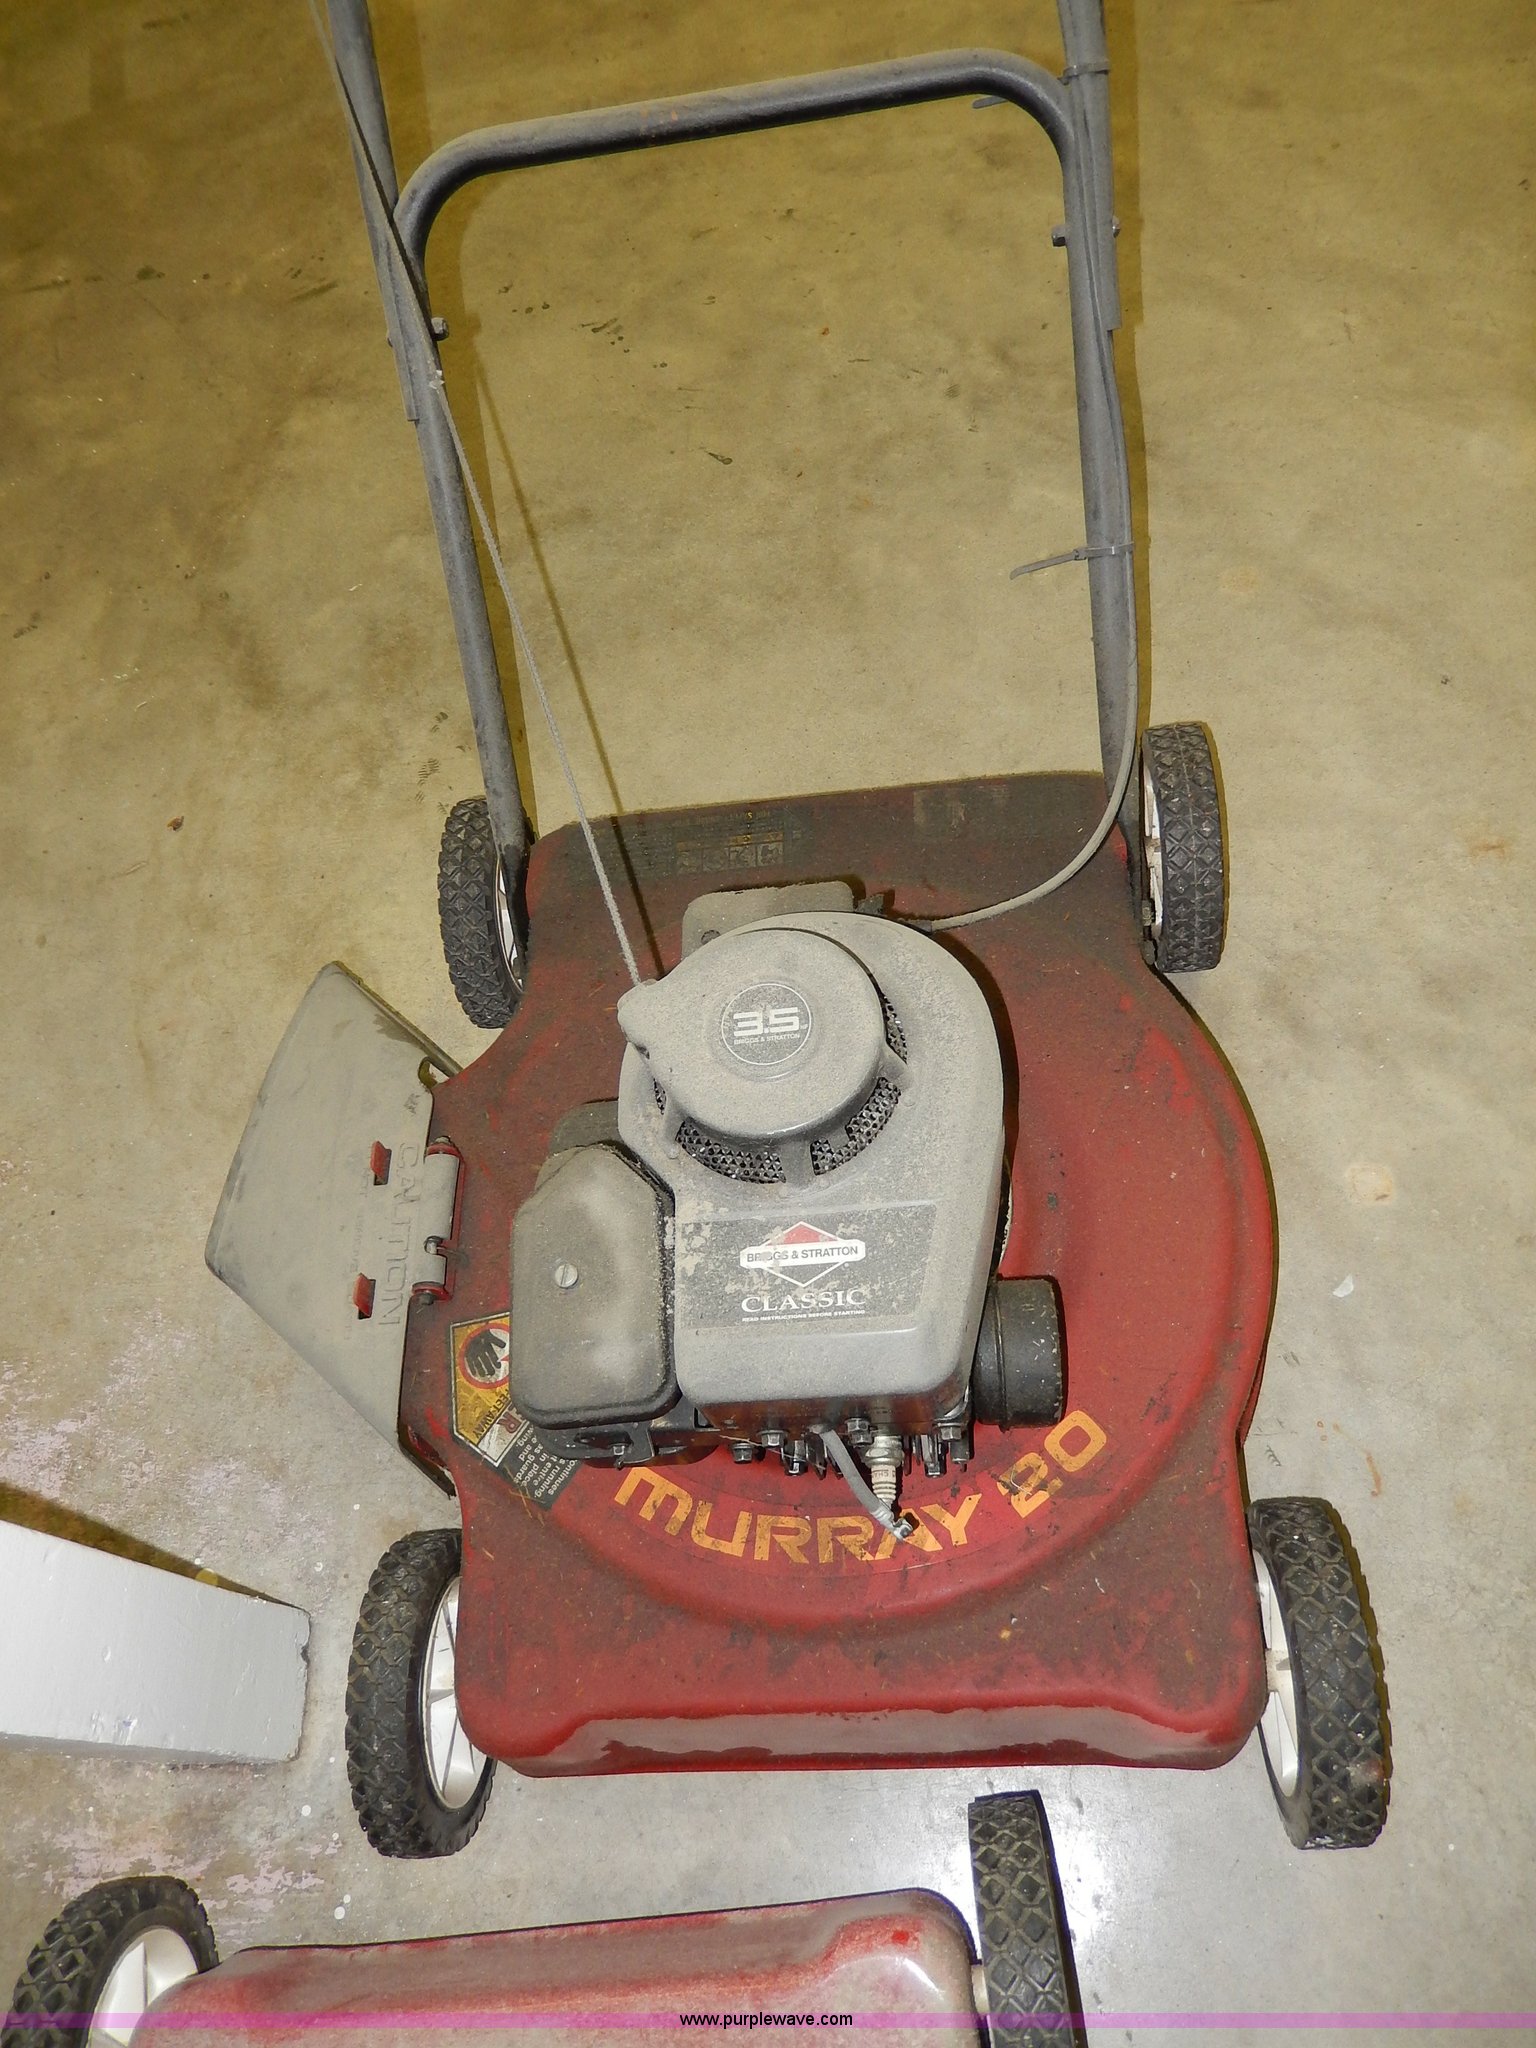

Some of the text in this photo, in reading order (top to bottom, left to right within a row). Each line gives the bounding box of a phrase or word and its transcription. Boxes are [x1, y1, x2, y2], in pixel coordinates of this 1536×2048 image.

[733, 1007, 800, 1037] 3.5
[746, 1245, 859, 1263] BRGS & STRATTON
[741, 1289, 867, 1313] CLASSIC
[760, 1313, 808, 1322] INSTRUCTIONS
[808, 1311, 833, 1319] BEFORE
[833, 1309, 867, 1317] STARTING
[518, 1443, 533, 1461] and
[533, 1463, 552, 1487] entire
[534, 1466, 561, 1499] running.
[614, 1409, 1107, 1564] MURRAY 20
